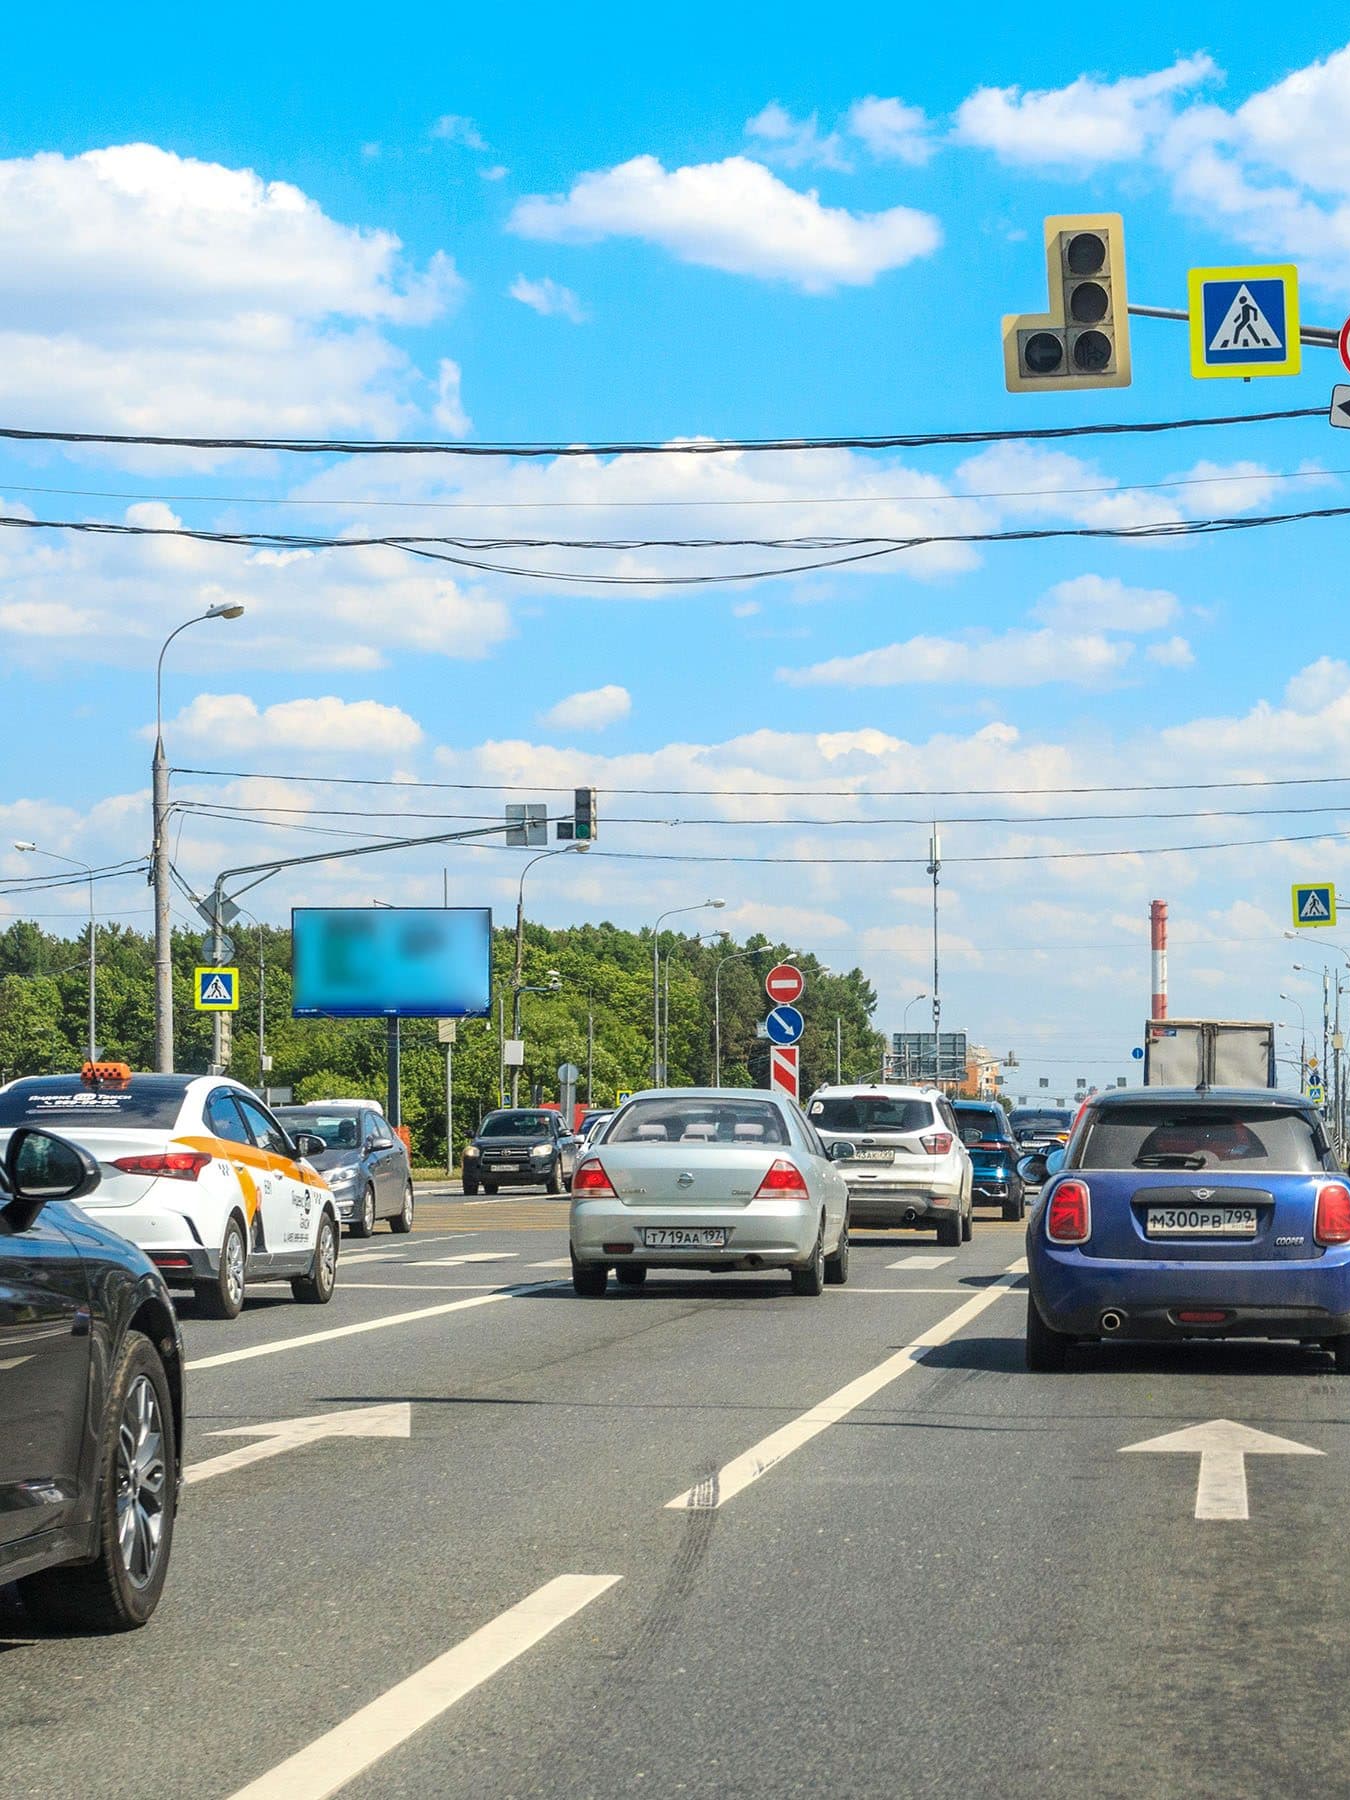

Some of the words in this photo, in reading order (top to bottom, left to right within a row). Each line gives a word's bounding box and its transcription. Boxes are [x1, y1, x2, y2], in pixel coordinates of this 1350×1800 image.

[1225, 1210, 1251, 1223] 799
[702, 1230, 721, 1240] 197
[1275, 1236, 1304, 1246] COOPER
